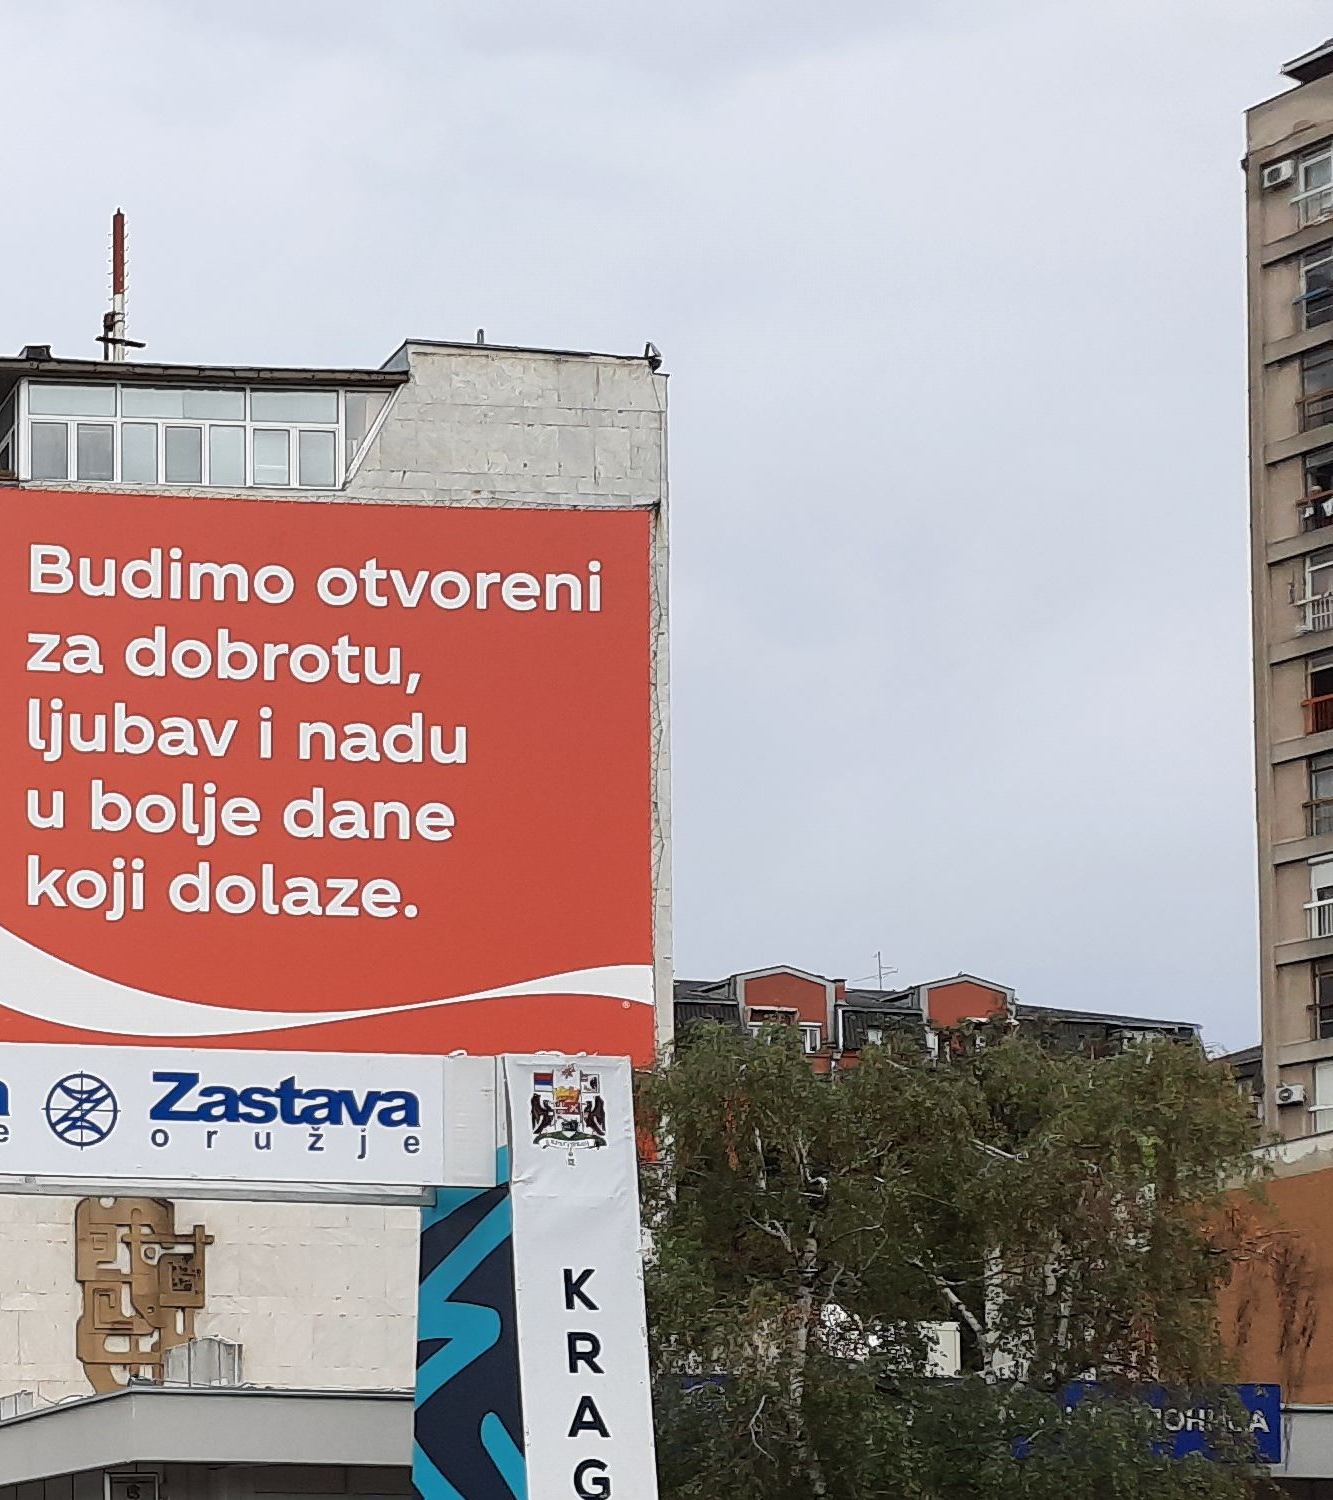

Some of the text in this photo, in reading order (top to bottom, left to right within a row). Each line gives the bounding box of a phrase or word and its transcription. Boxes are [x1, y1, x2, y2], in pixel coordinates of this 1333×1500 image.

[29, 544, 603, 612] Budimo otvoreni
[26, 626, 421, 695] za dobrotu,
[27, 698, 468, 764] ljubav i nadu
[26, 780, 455, 845] u bolje dane
[27, 854, 419, 921] koji dolaze.
[150, 1071, 420, 1129] Zastava
